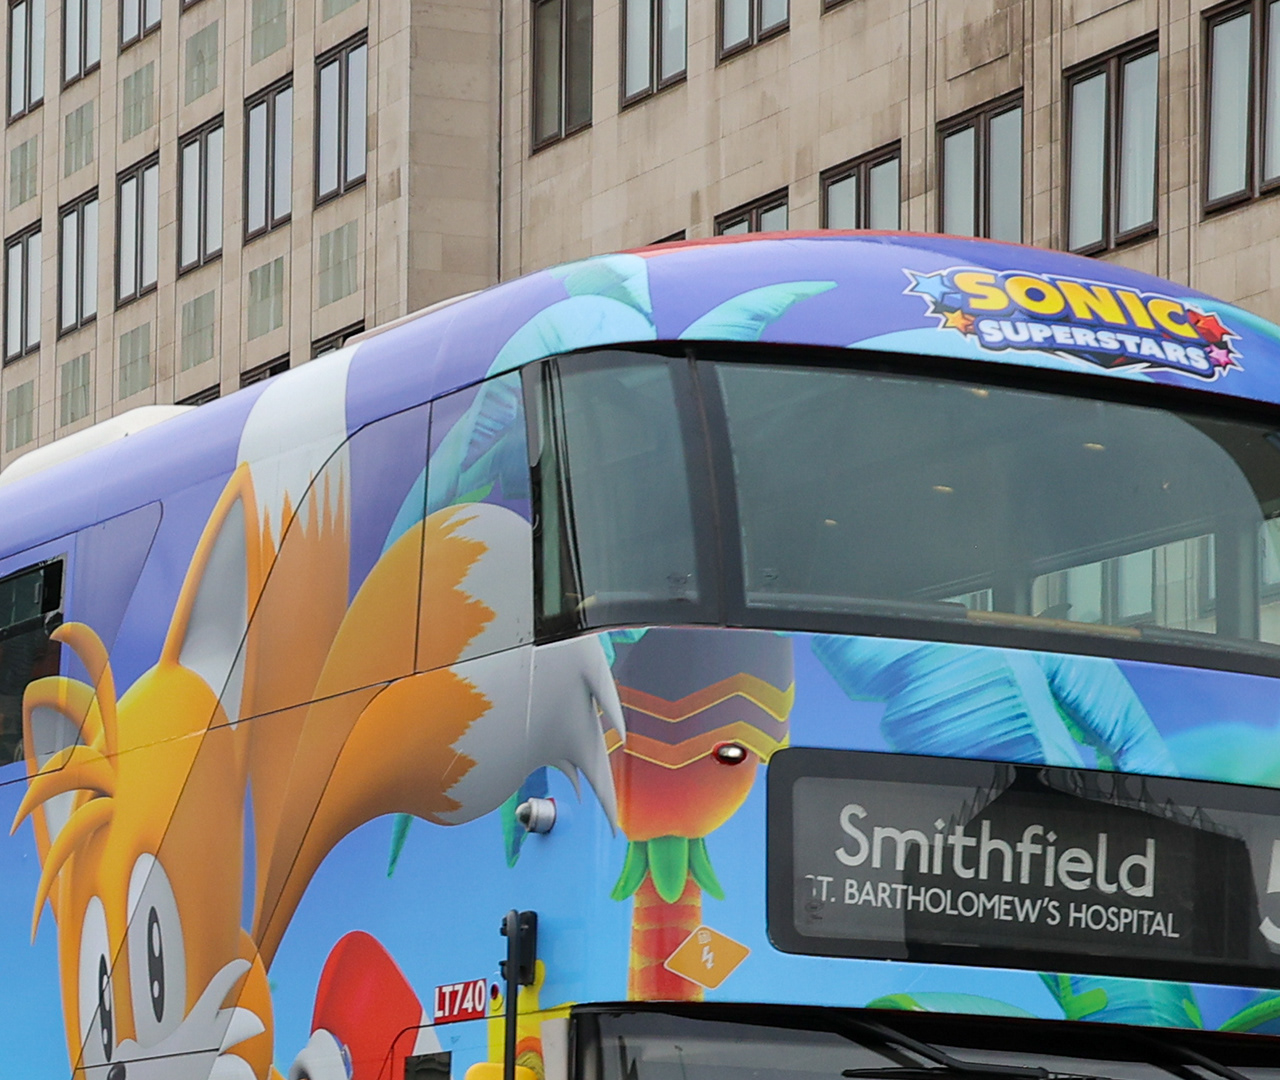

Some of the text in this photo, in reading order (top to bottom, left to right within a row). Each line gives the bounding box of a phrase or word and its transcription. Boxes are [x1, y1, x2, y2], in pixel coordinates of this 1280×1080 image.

[953, 272, 1200, 339] SONIC
[976, 319, 1209, 371] SUPERSTARS
[835, 803, 1156, 898] Smithfield
[844, 878, 1062, 926] BARTHOLOMEW'S
[1068, 902, 1181, 939] HOSPITAL
[434, 980, 486, 1018] LT740
